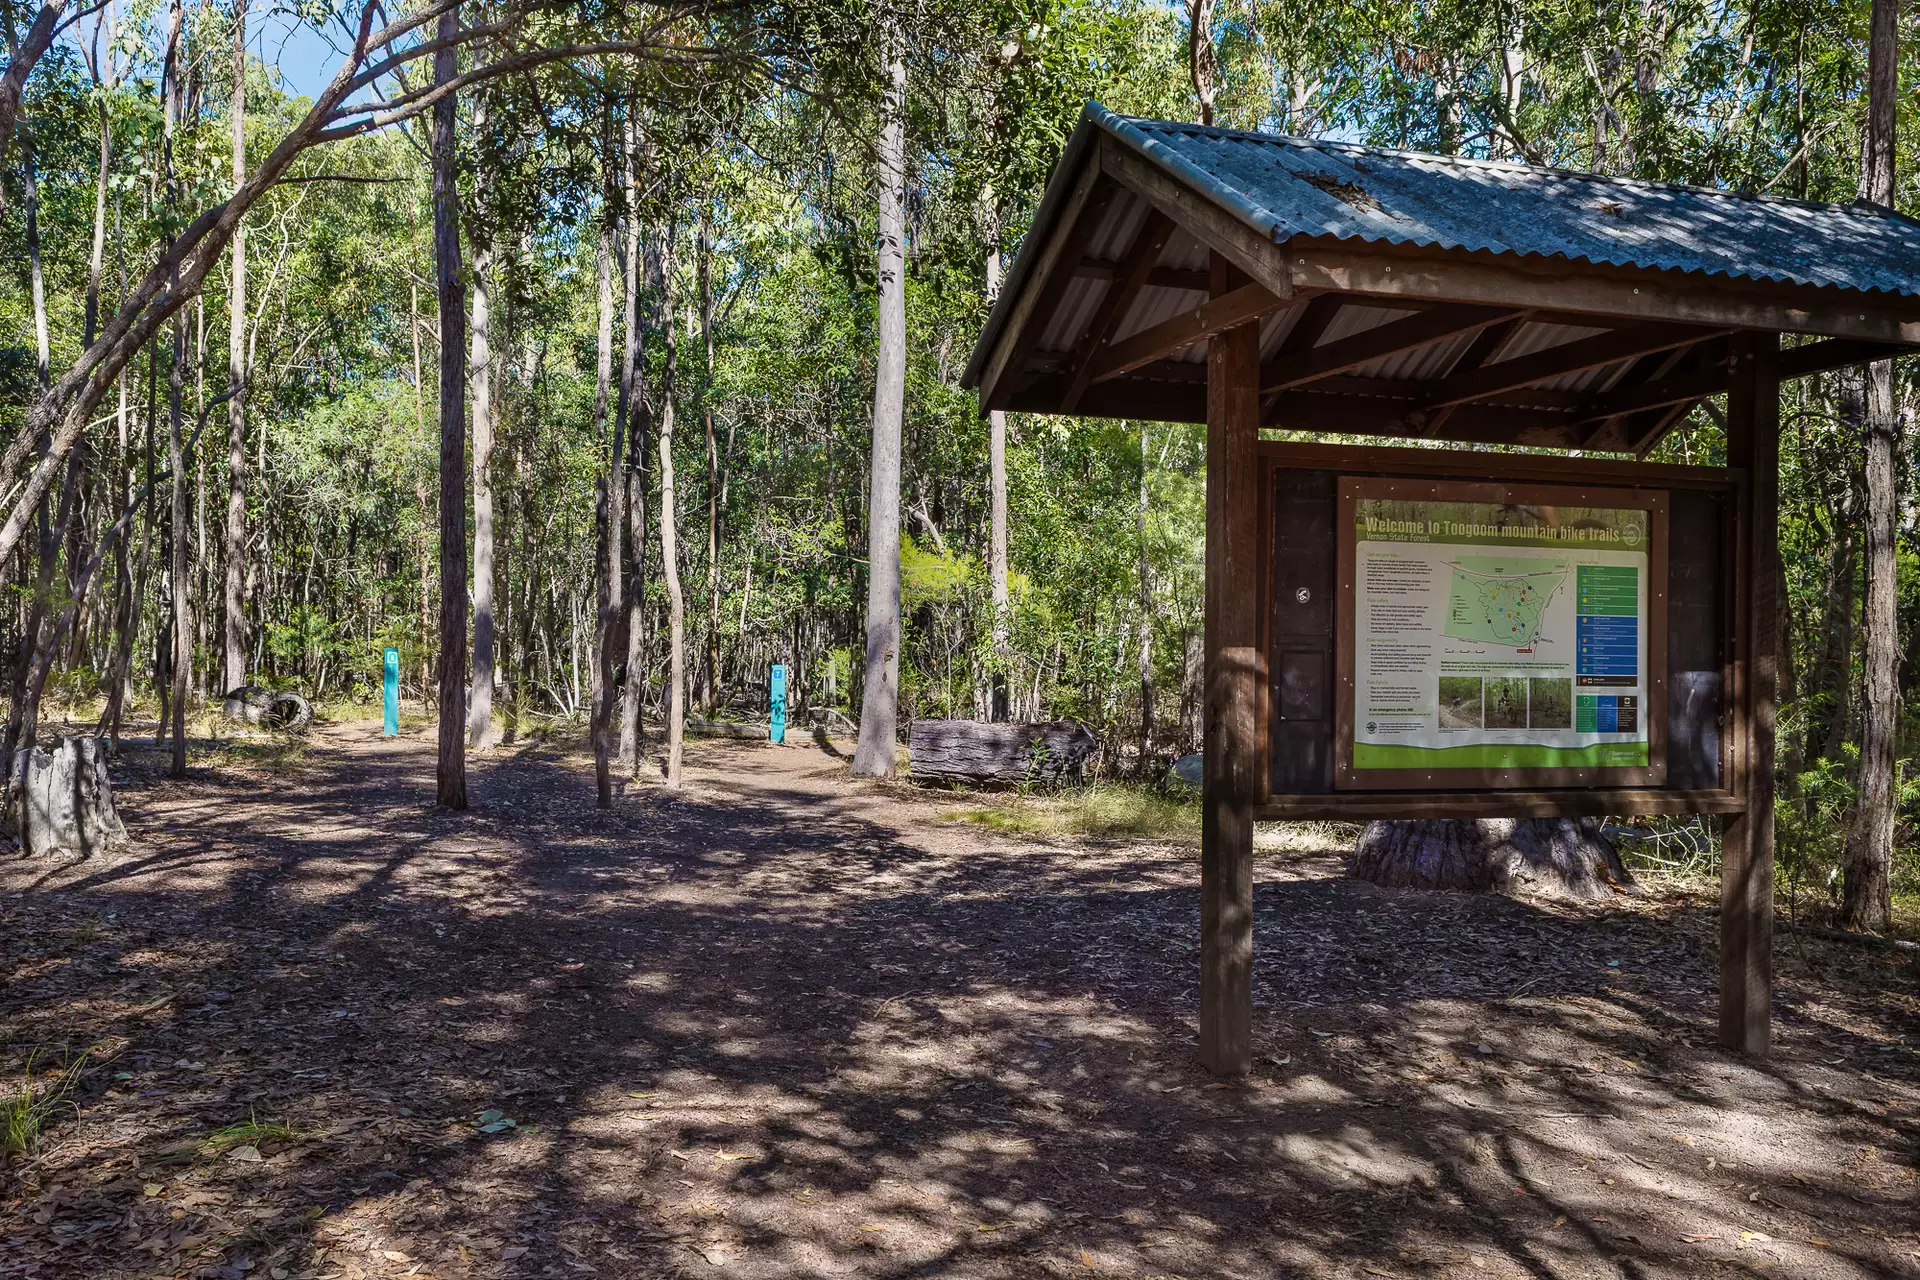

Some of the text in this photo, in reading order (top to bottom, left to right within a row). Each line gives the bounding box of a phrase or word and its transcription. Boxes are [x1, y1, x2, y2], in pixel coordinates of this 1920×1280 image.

[1365, 517, 1424, 534] Welcome
[1428, 520, 1440, 535] to
[1443, 520, 1498, 538] Toogoom
[1501, 524, 1557, 540] mountain
[1560, 525, 1585, 541] bike
[1589, 527, 1619, 542] trails
[1366, 532, 1430, 542] Vernon State Forest
